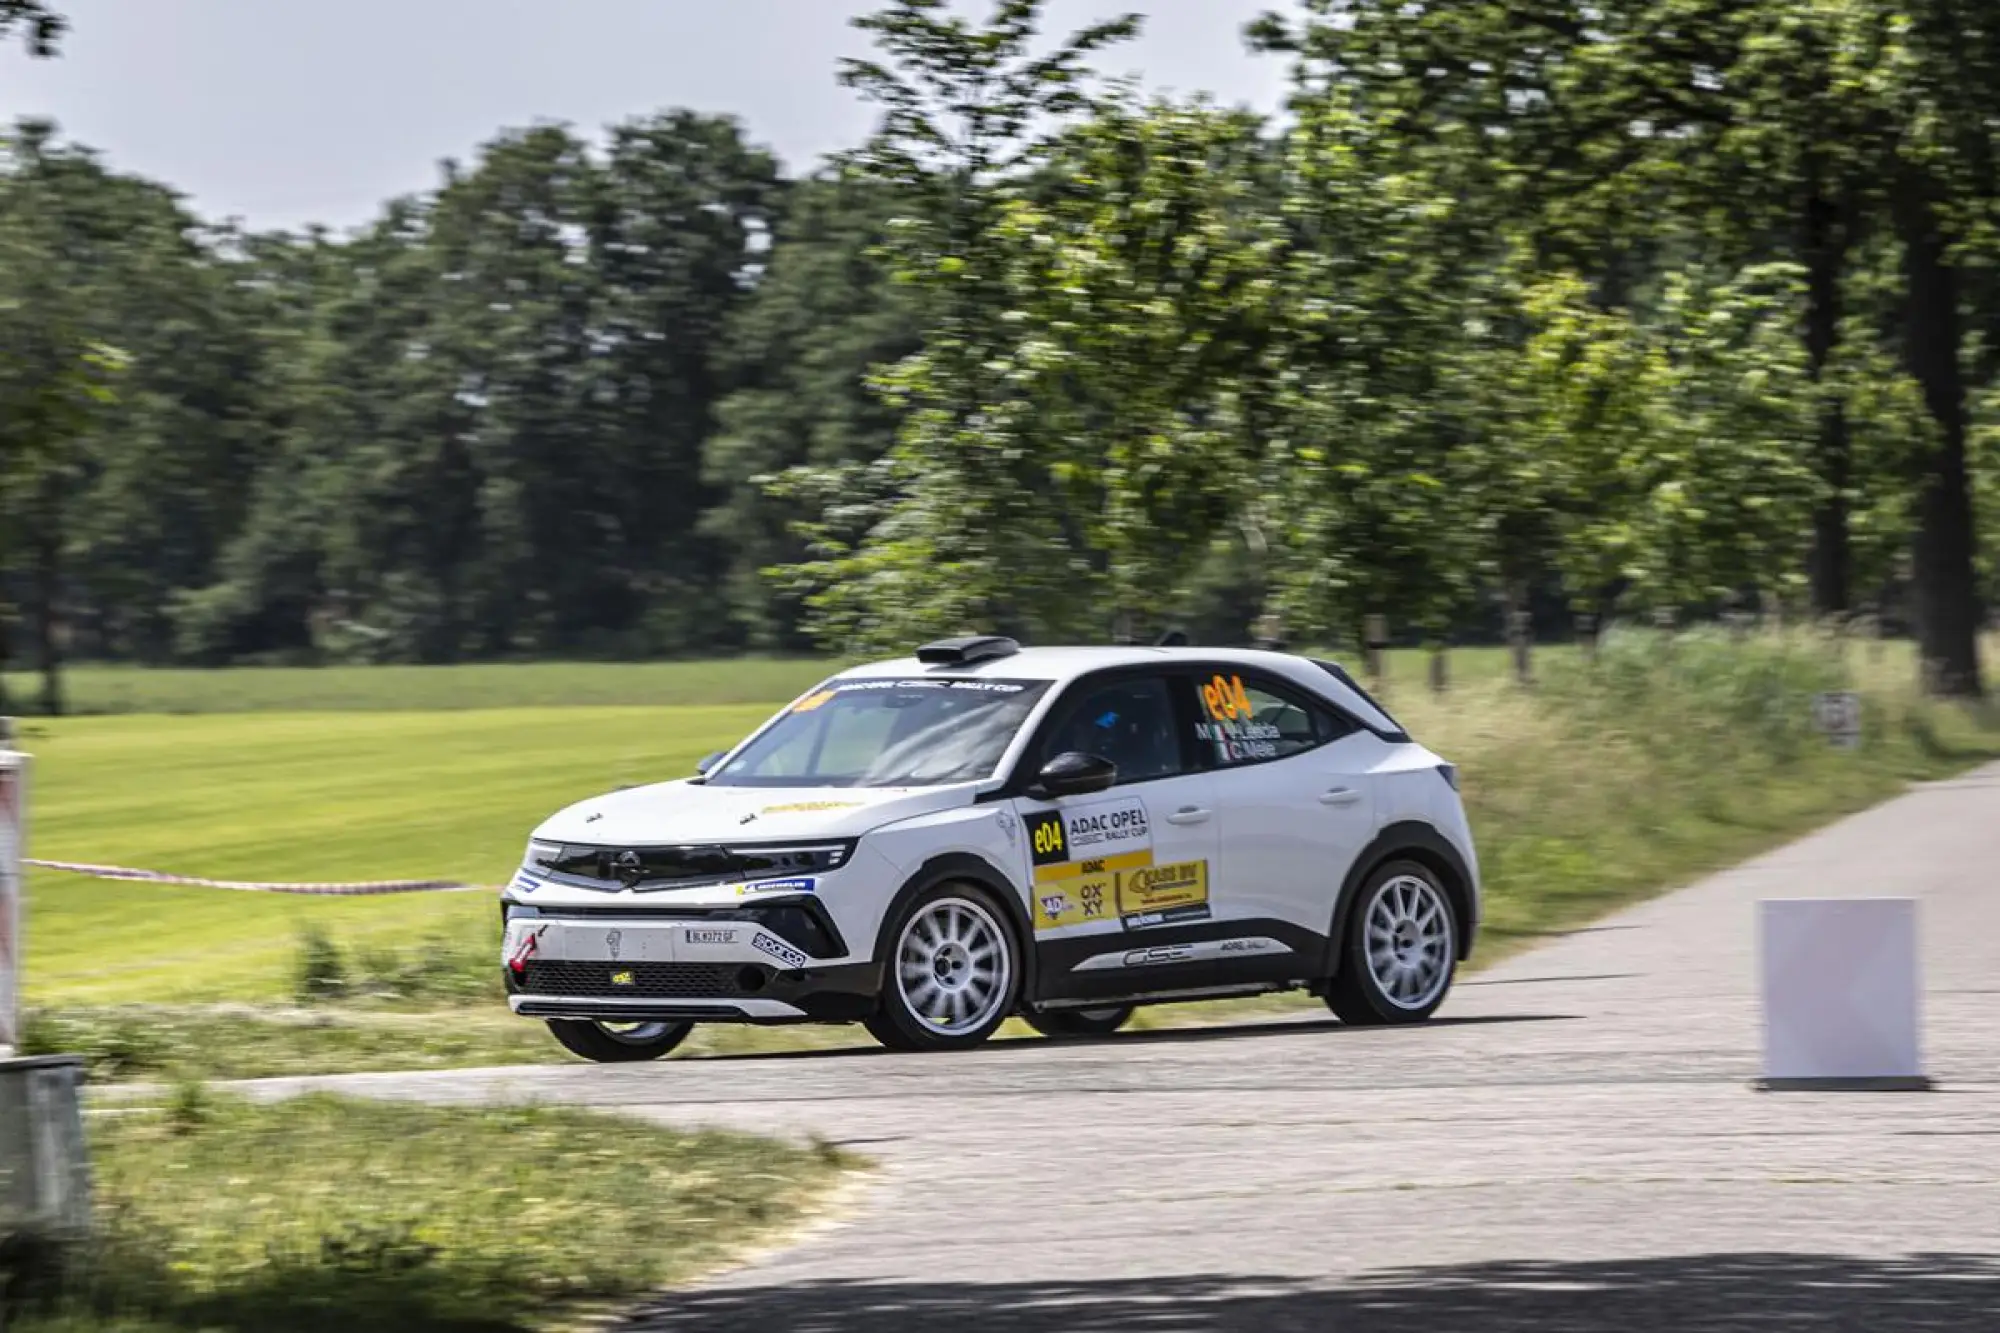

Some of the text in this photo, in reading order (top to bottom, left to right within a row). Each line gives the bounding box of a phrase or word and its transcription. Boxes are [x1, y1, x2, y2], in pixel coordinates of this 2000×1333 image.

[1203, 674, 1253, 720] e04
[1070, 808, 1146, 835] ADAC OPEL
[1105, 829, 1129, 841] RALLY
[1131, 826, 1148, 838] CUP
[1034, 820, 1063, 854] e04
